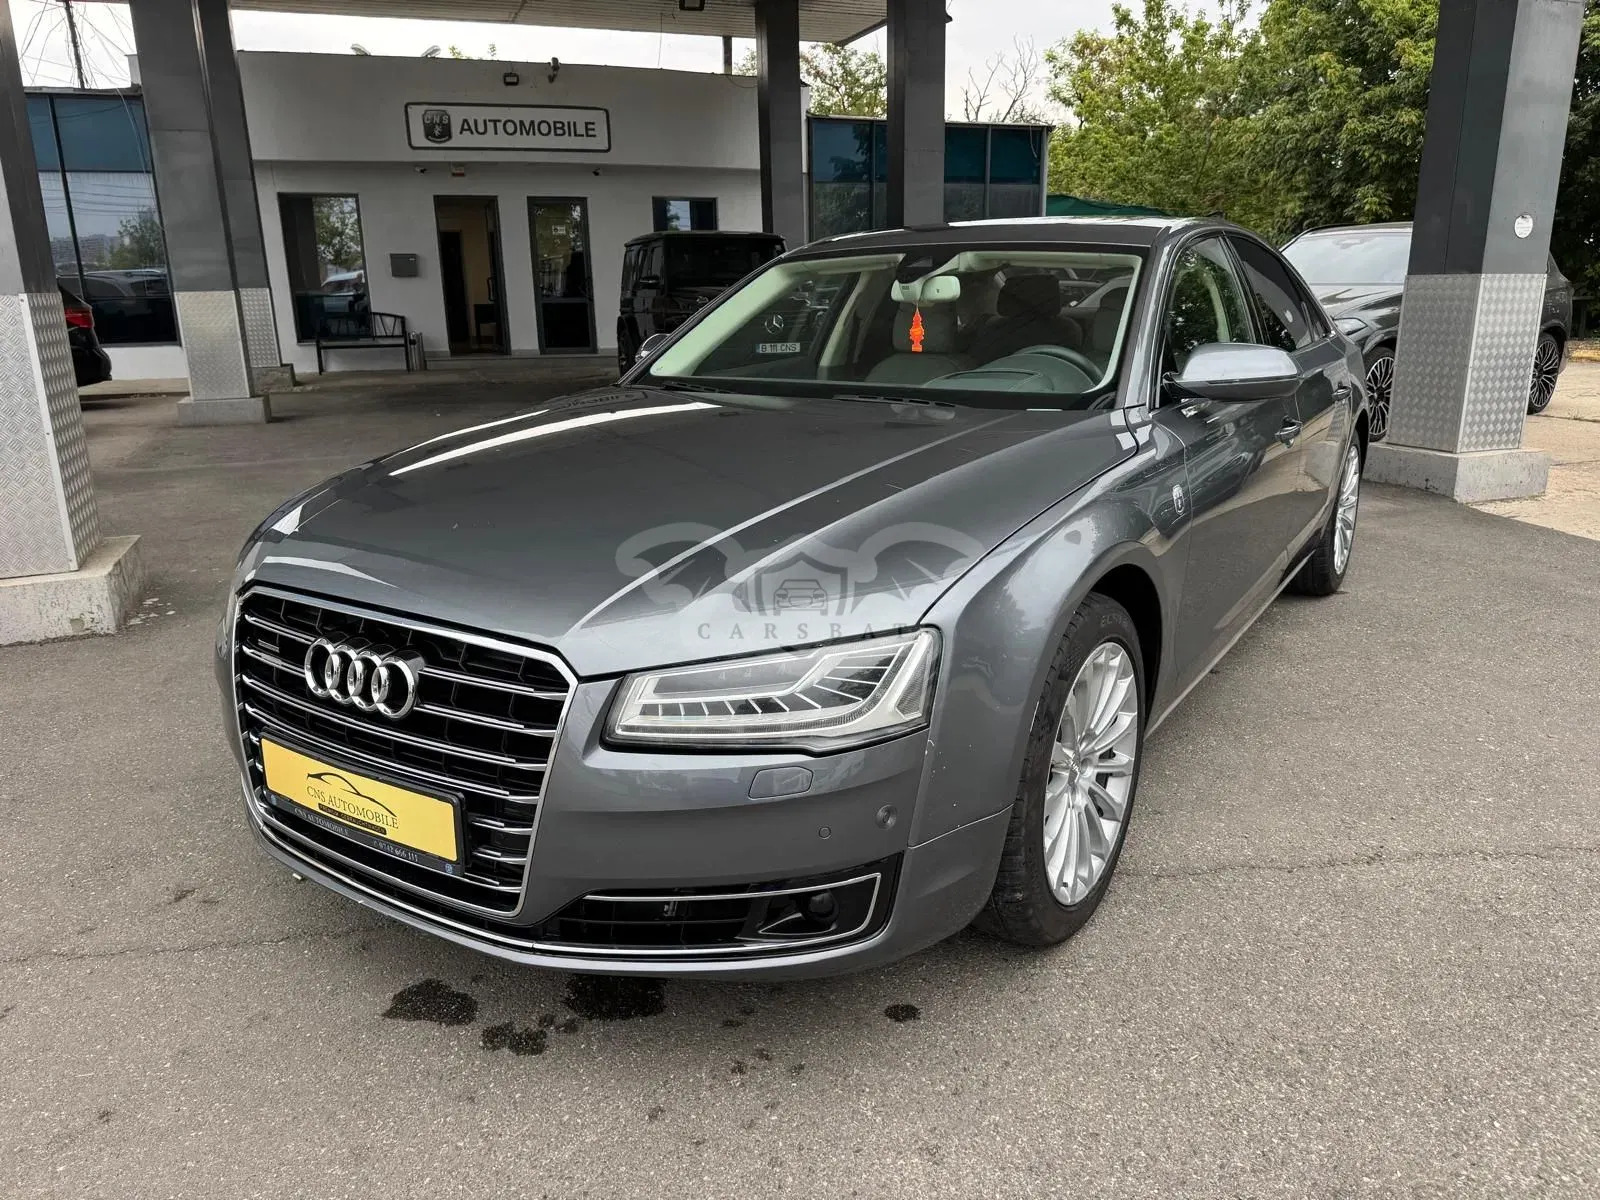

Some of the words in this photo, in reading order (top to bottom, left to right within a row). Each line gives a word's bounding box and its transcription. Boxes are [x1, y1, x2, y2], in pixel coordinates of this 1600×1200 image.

[424, 113, 449, 124] CNS
[459, 118, 597, 138] AUTOMOBILE
[761, 344, 767, 353] B
[780, 343, 797, 352] CNS
[306, 785, 326, 803] CNS
[327, 794, 400, 829] AUTOMOBILE
